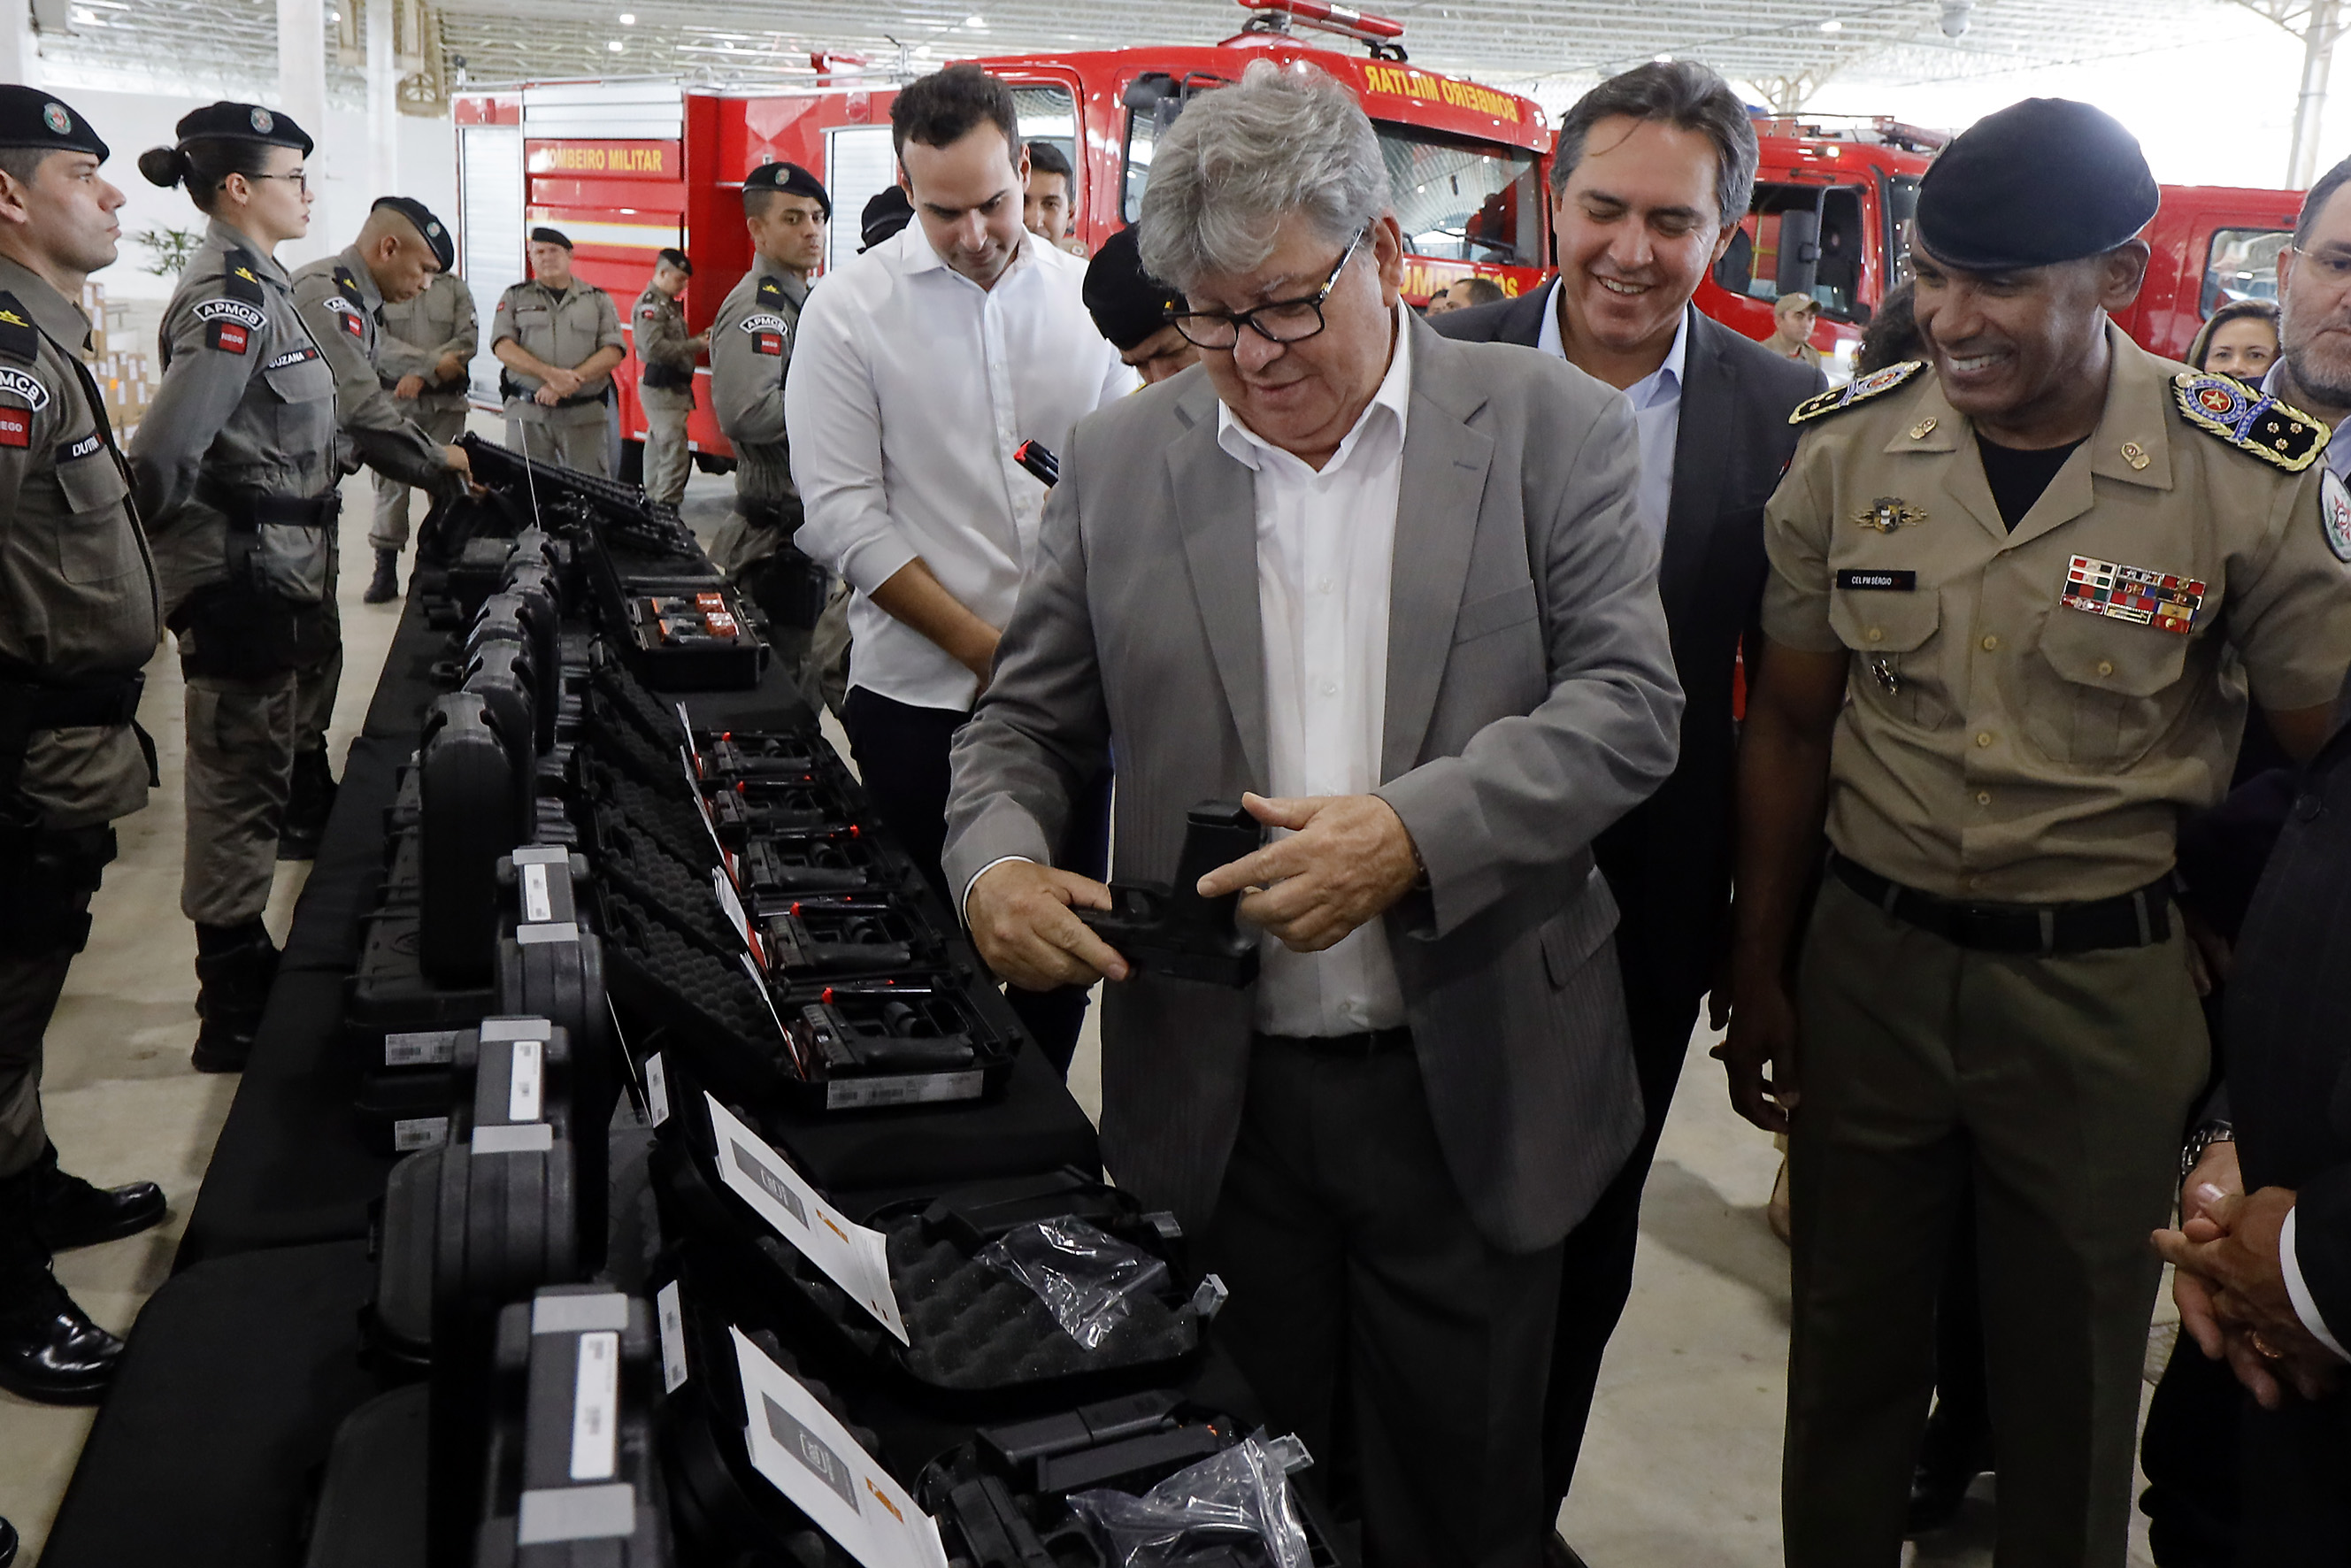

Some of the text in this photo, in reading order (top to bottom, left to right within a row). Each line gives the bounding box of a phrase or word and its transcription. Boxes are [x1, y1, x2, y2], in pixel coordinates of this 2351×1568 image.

[542, 148, 663, 172] OMBEIRO MILITAR
[204, 302, 259, 326] APMCB
[1851, 576, 1863, 585] CEL
